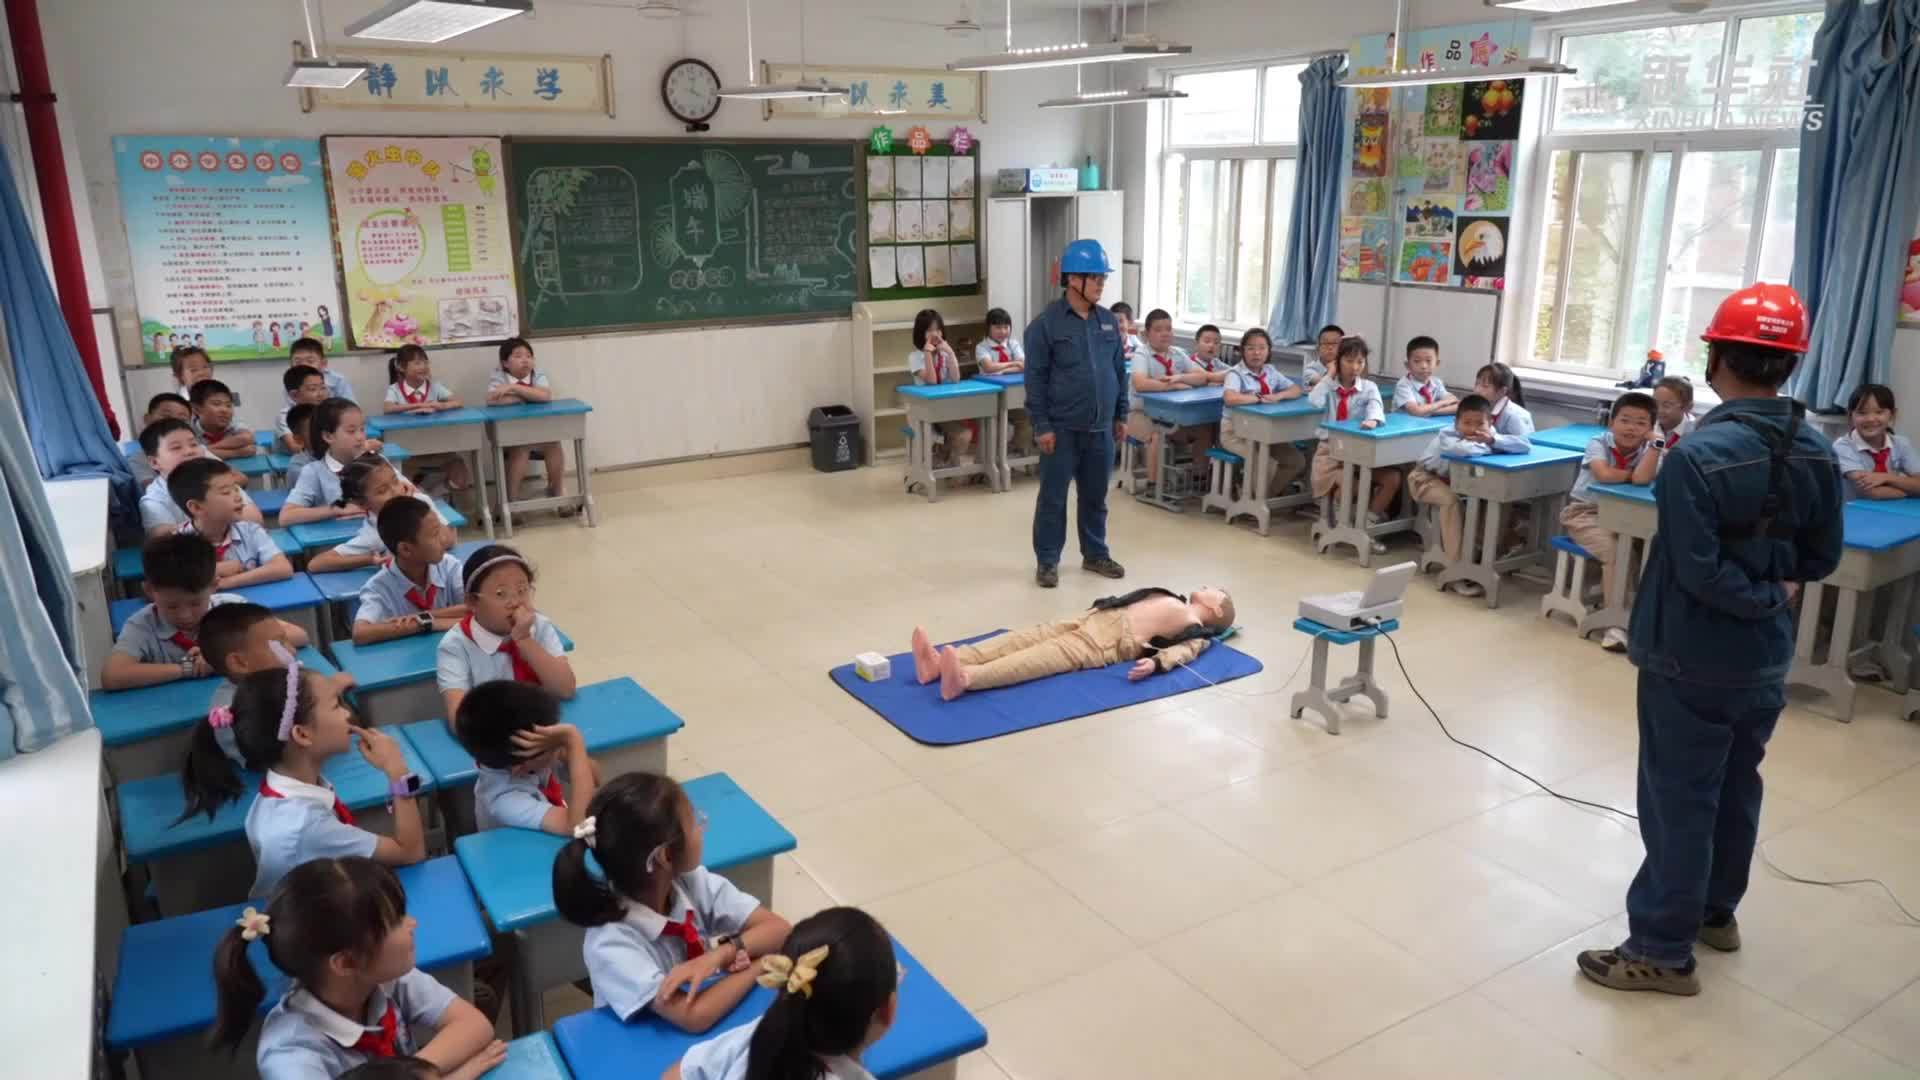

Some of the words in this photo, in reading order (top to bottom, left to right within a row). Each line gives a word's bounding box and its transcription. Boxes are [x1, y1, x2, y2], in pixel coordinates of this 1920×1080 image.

[873, 130, 969, 149] 作品栏
[682, 183, 708, 245] 端午
